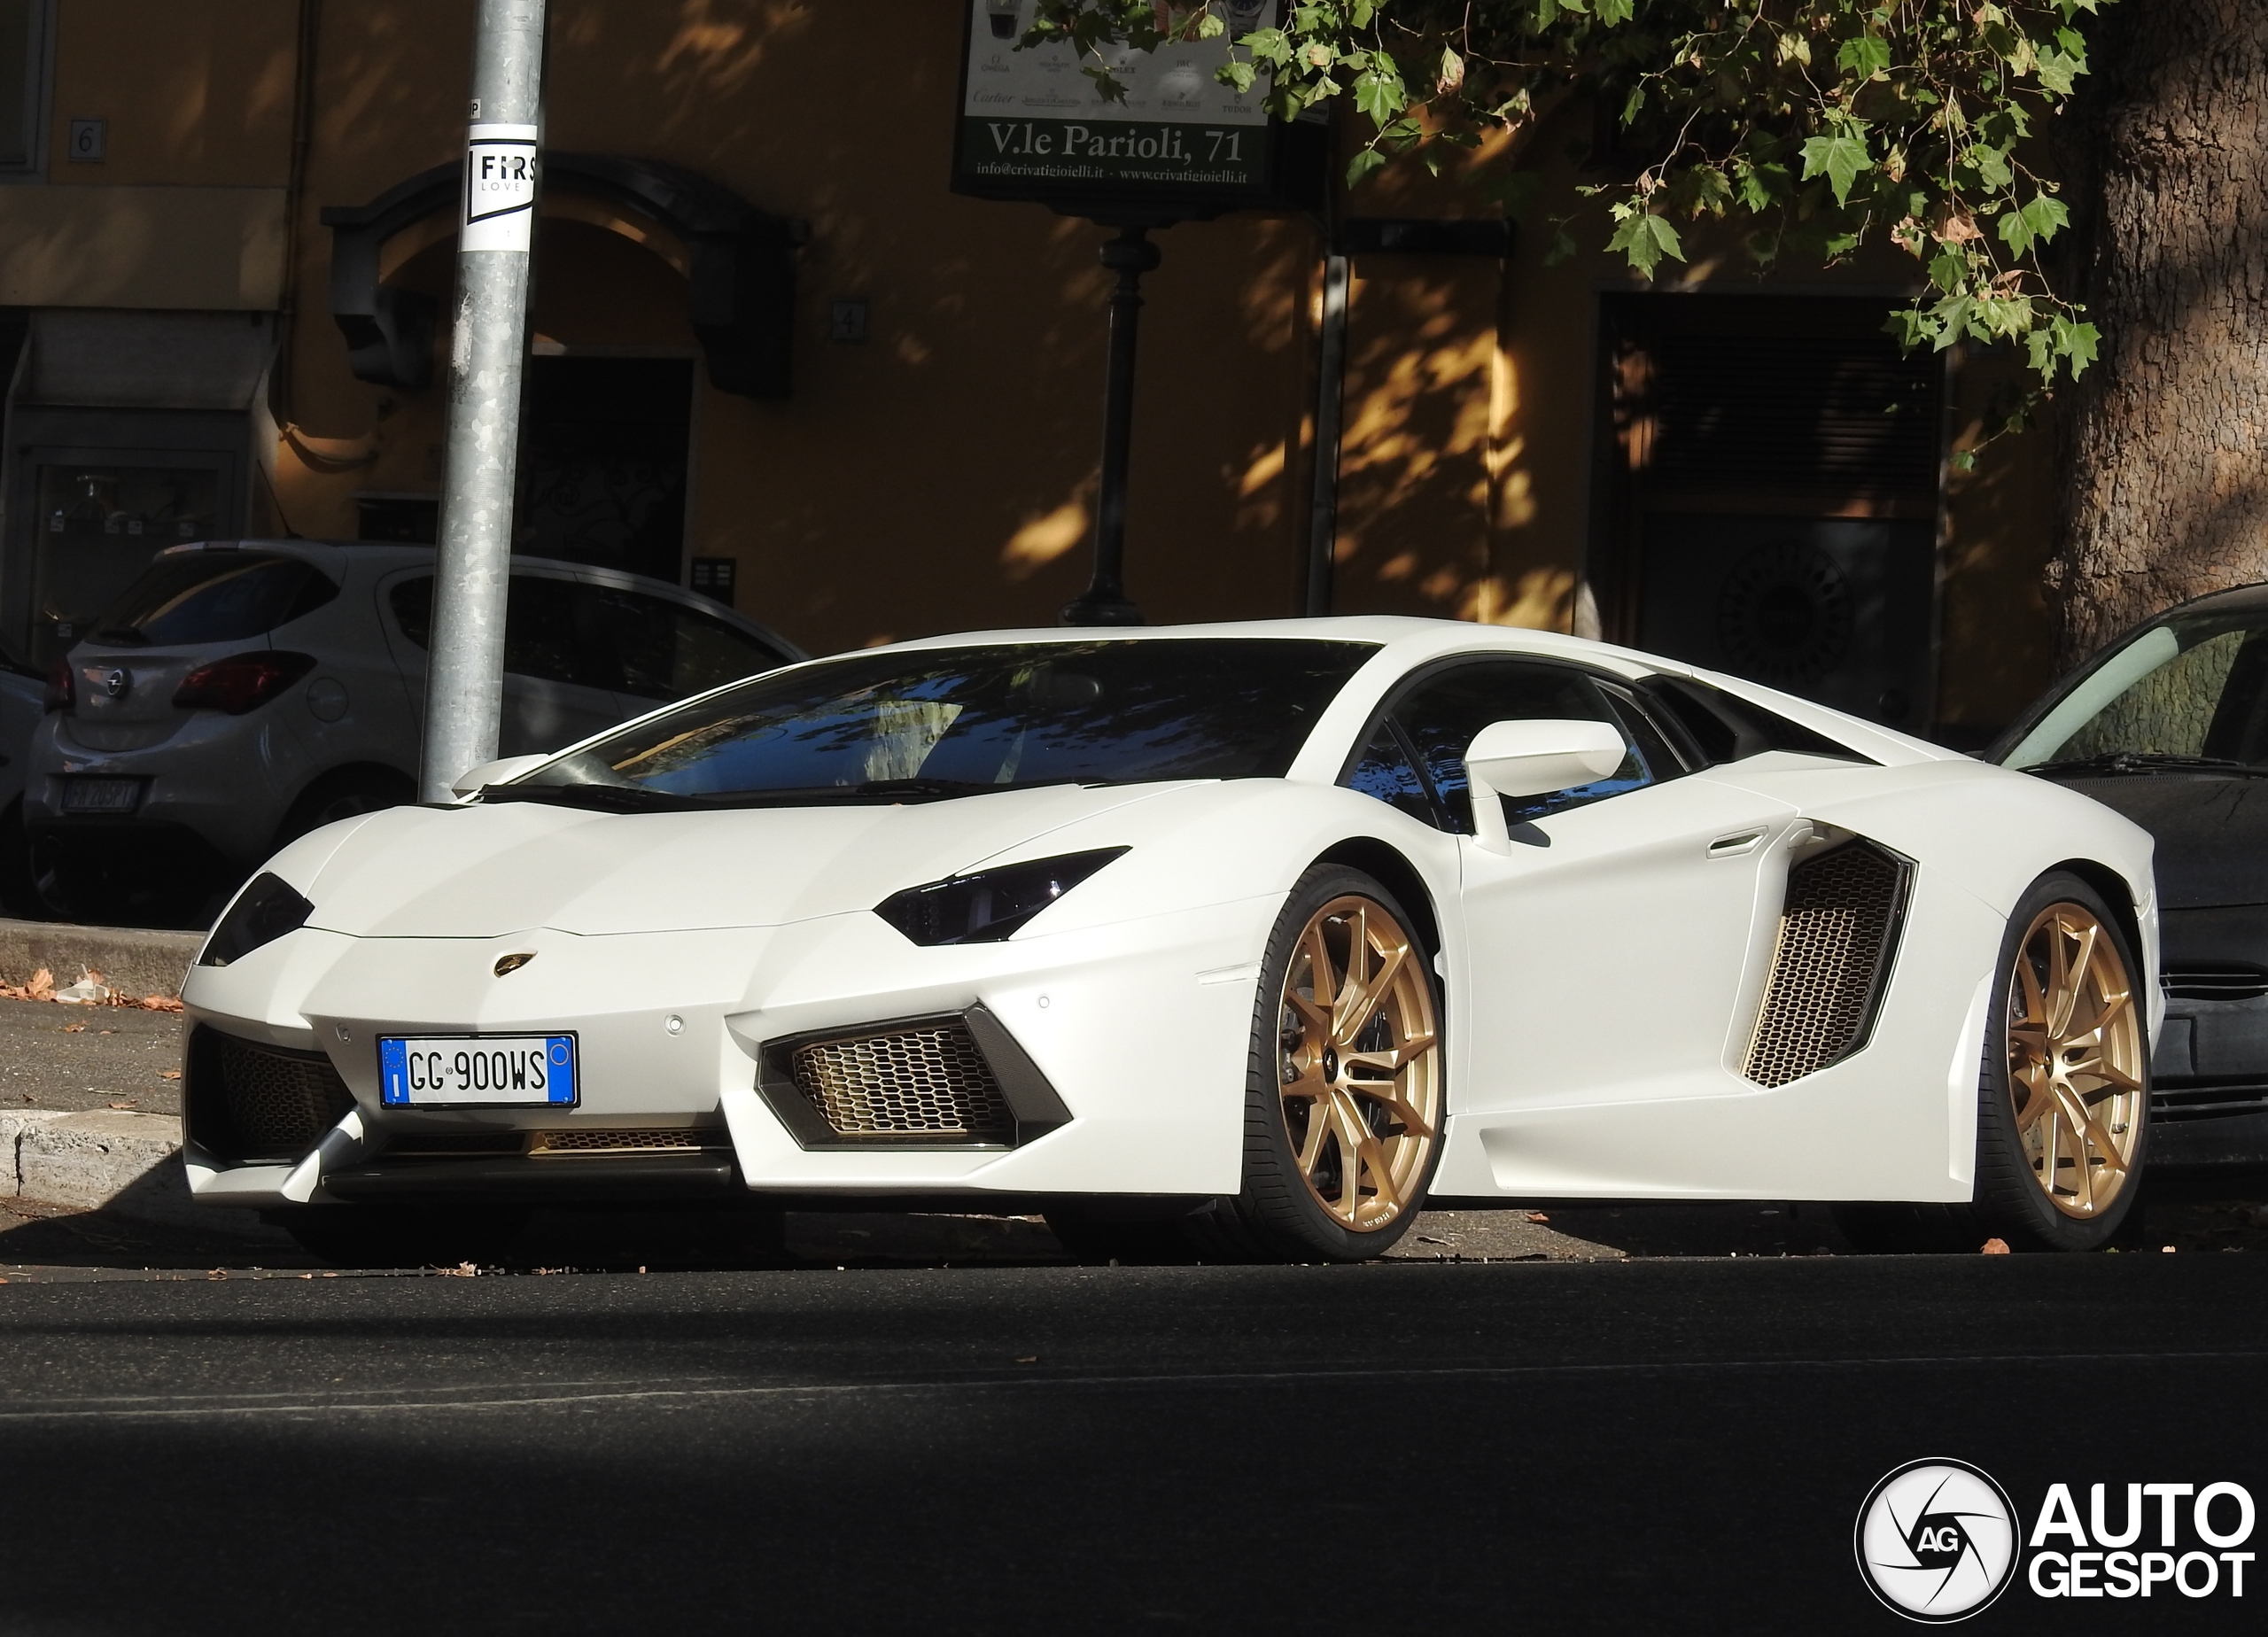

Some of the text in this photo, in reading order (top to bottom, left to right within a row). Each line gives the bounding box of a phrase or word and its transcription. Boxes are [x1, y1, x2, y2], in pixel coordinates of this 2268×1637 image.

[981, 64, 1010, 73] OMEGA
[973, 89, 1015, 104] Cartier
[1223, 105, 1252, 114] TUDOR
[79, 128, 93, 151] 6
[987, 122, 1242, 166] V.le Parioli, 71
[976, 161, 1104, 178] info@crivatigioielli.it
[1120, 168, 1248, 184] www.crivatigioielli.it
[481, 182, 521, 191] LOVE
[842, 308, 855, 333] 4
